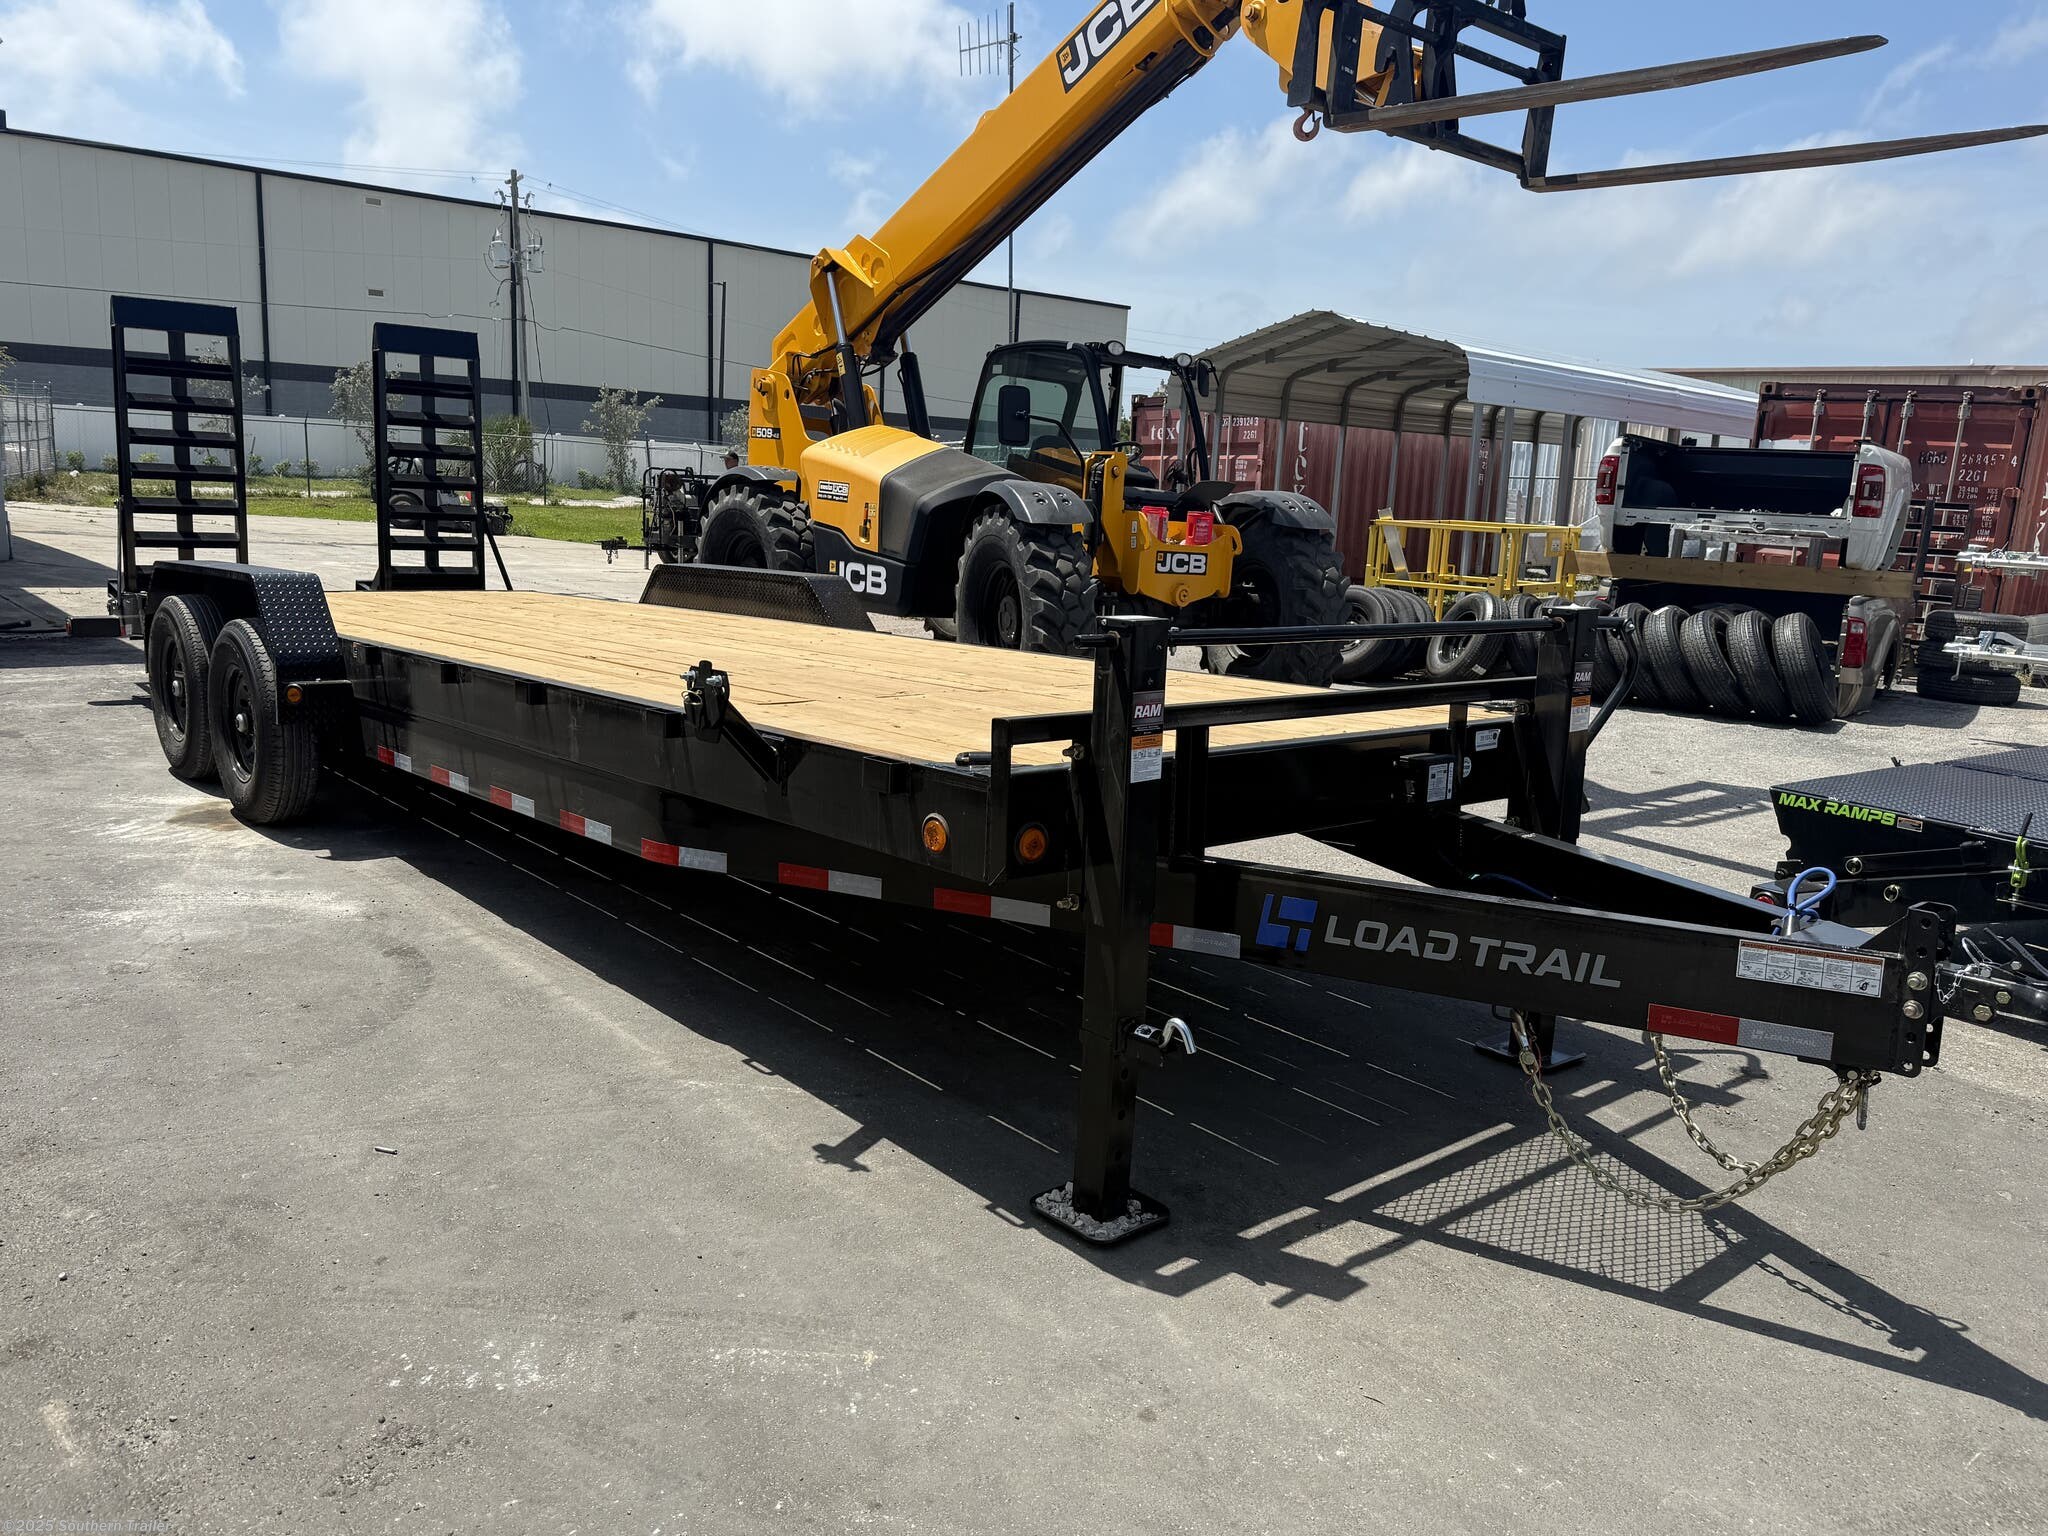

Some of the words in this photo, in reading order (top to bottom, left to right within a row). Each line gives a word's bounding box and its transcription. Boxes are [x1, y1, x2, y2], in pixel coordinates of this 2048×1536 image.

[1157, 553, 1206, 574] JCB
[1574, 672, 1591, 682] RAM
[1134, 704, 1162, 718] RAM
[1778, 793, 1821, 811] MAX
[1823, 801, 1897, 827] RAMPS
[1324, 915, 1458, 962] LOAD
[1470, 936, 1622, 988] TRAIL
